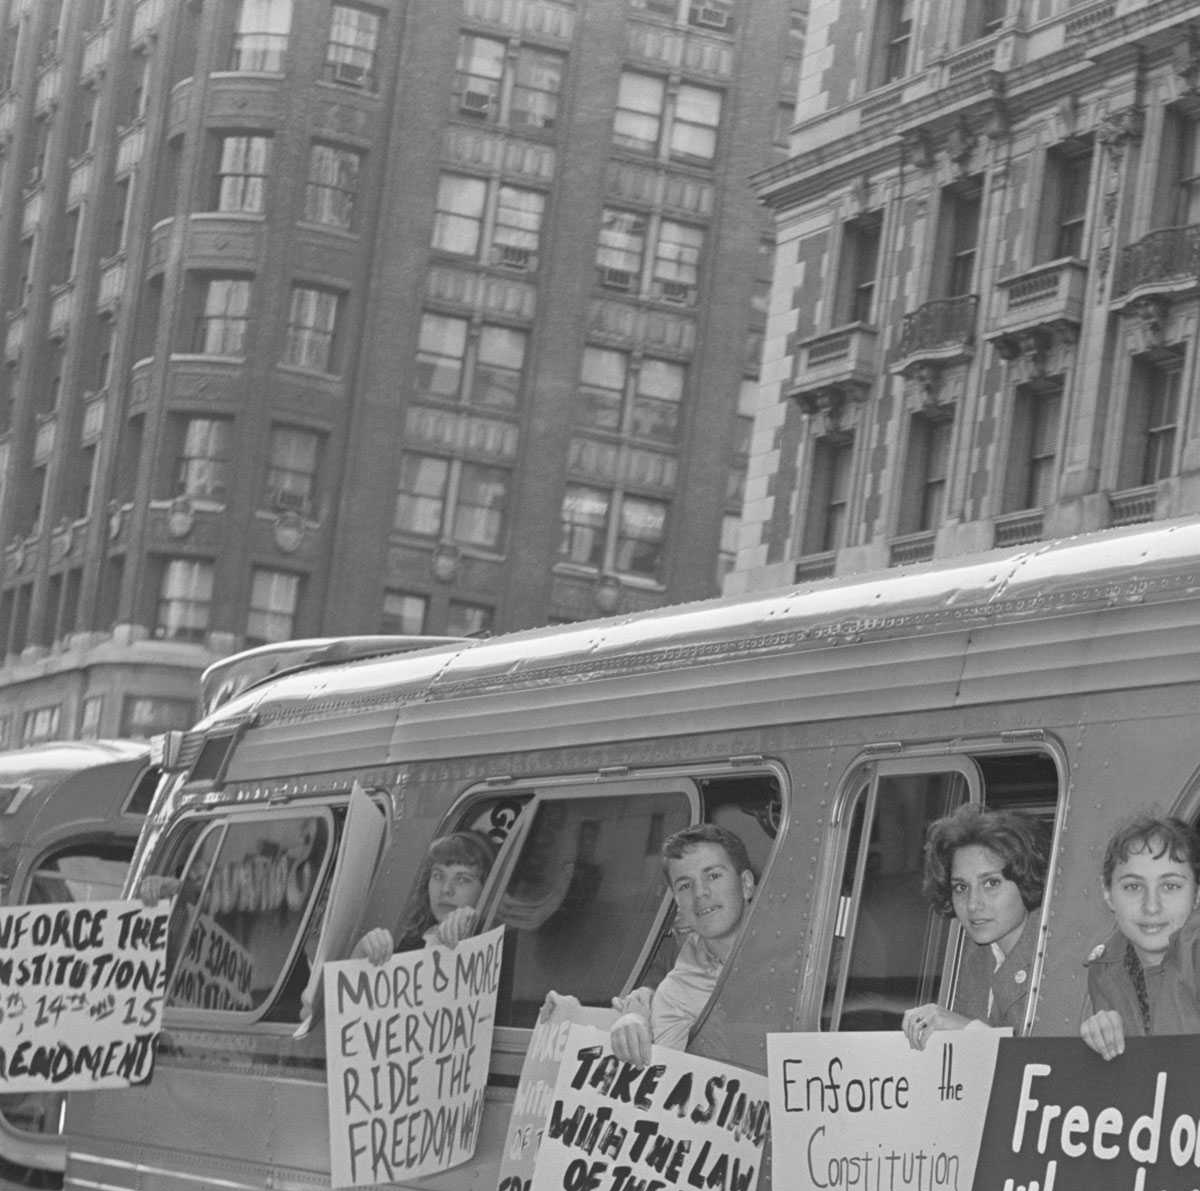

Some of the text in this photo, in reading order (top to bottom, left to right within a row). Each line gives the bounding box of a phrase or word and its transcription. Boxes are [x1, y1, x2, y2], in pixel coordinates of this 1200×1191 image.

[117, 909, 168, 951] THE
[337, 936, 502, 1014] MORE & MORE
[122, 996, 164, 1028] 15
[0, 1032, 160, 1087] ENDMENTS
[343, 1044, 476, 1115] RIDE THE
[570, 1045, 667, 1111] TAKE
[663, 1071, 693, 1118] A
[783, 1042, 964, 1114] Enforce the
[349, 1105, 460, 1183] FREEDOM
[548, 1099, 628, 1160] WITH
[629, 1119, 692, 1184] THE
